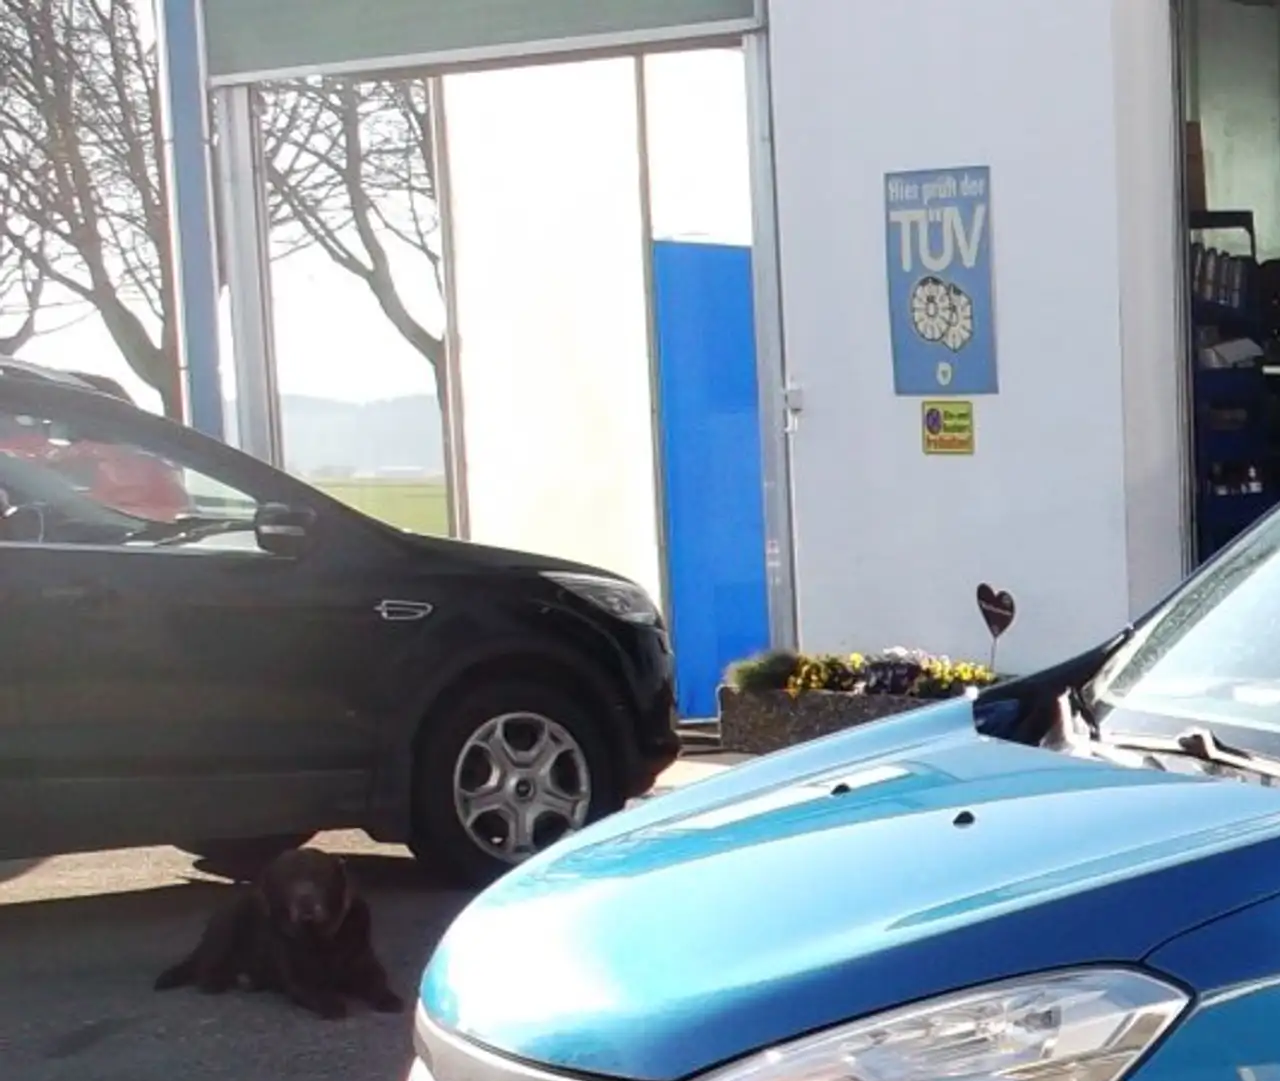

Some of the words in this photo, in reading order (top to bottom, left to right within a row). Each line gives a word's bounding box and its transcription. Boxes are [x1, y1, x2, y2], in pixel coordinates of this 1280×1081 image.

[888, 178, 919, 201] Hier
[960, 172, 984, 197] der
[889, 204, 985, 272] TÜV
